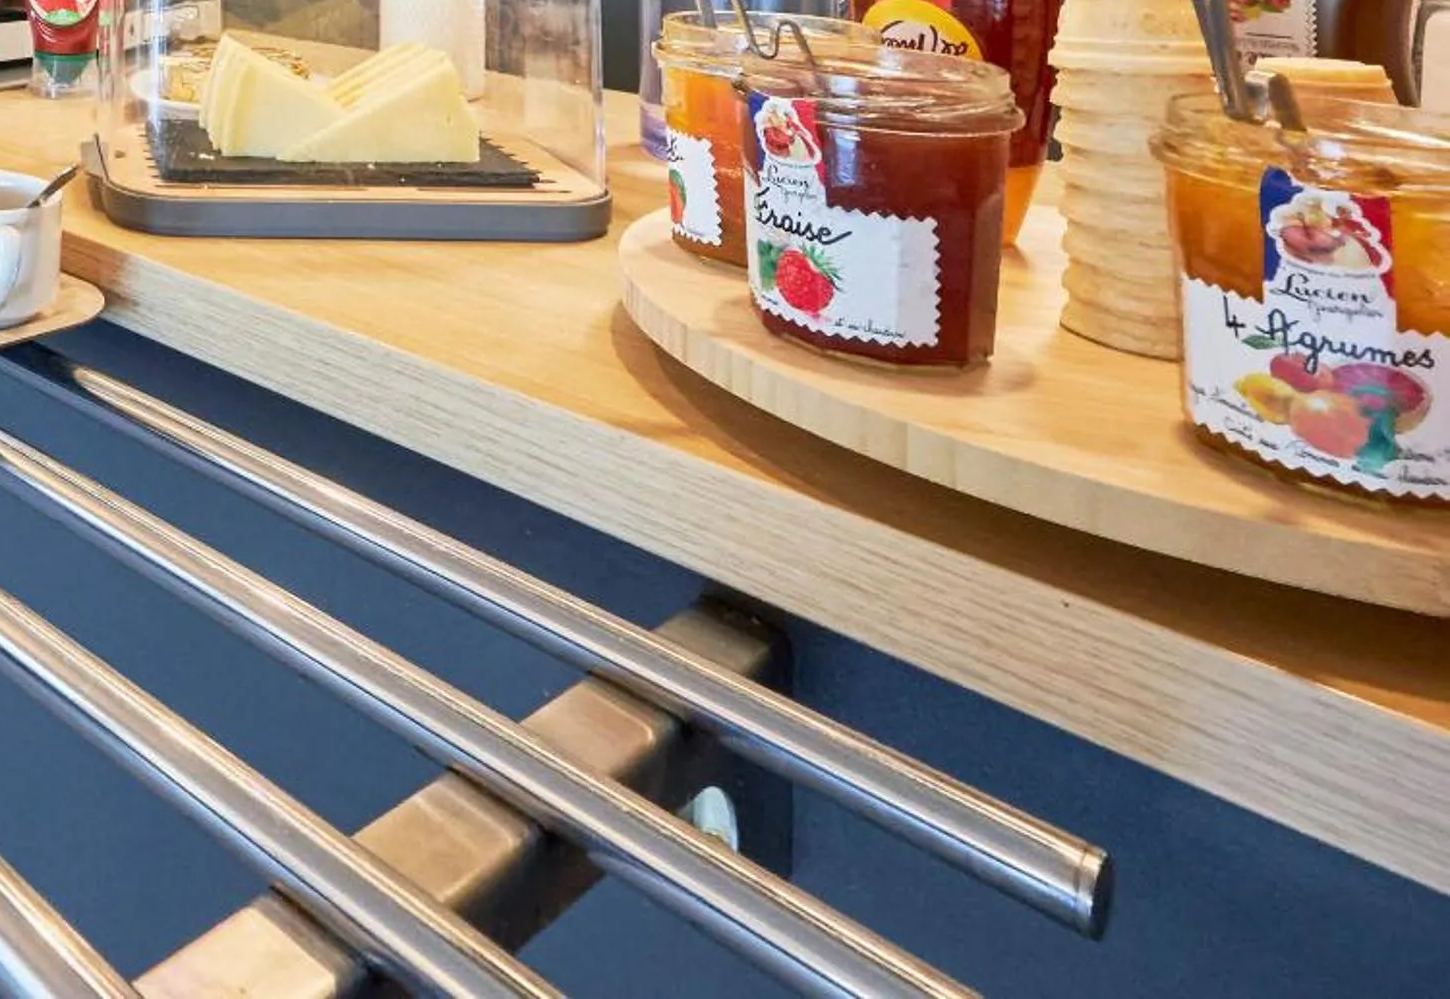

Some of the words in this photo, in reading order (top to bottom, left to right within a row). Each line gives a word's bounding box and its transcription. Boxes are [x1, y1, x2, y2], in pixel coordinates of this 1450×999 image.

[1269, 272, 1374, 304] Lucien
[1223, 294, 1247, 338] 4
[1254, 307, 1436, 375] Agrumes
